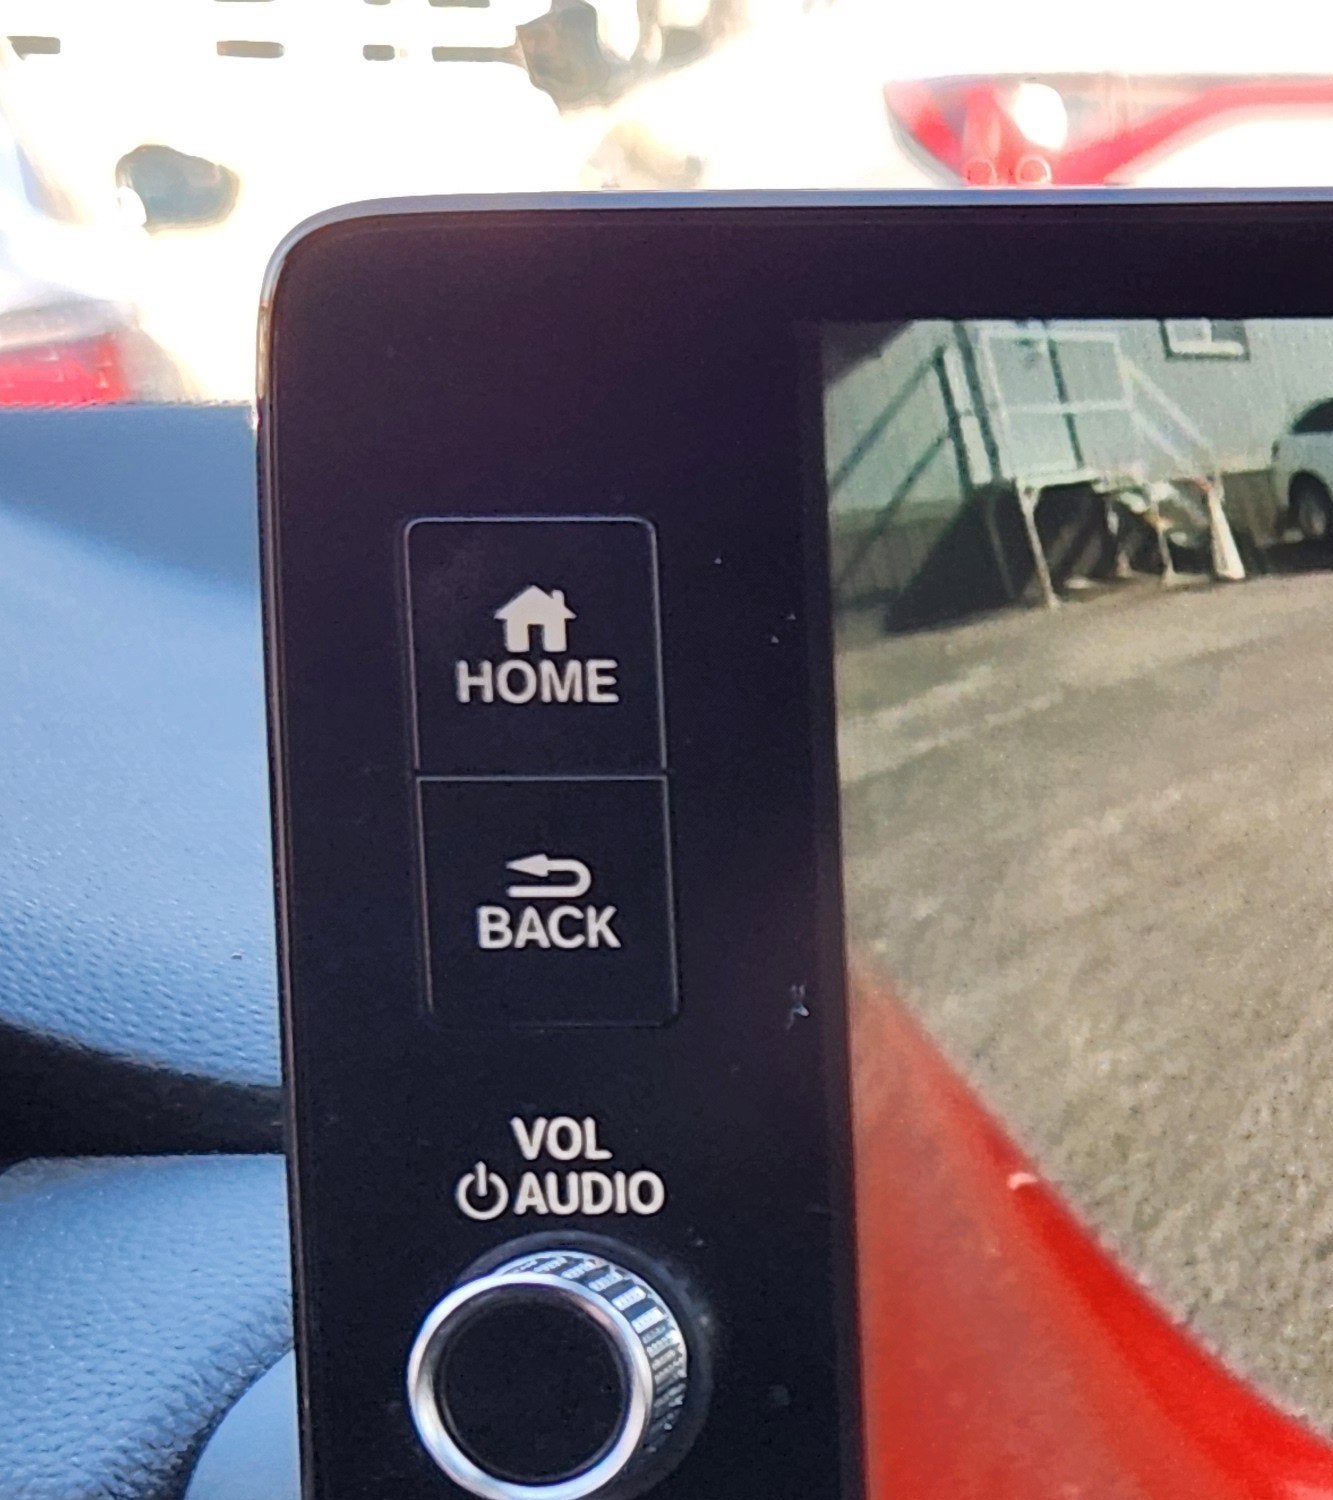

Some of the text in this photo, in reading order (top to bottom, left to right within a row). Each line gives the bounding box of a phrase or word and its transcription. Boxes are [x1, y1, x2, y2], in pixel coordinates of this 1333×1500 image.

[456, 659, 620, 705] HOME
[476, 905, 622, 950] BACK
[510, 1116, 613, 1162] VOL
[512, 1170, 666, 1216] AUDIO
